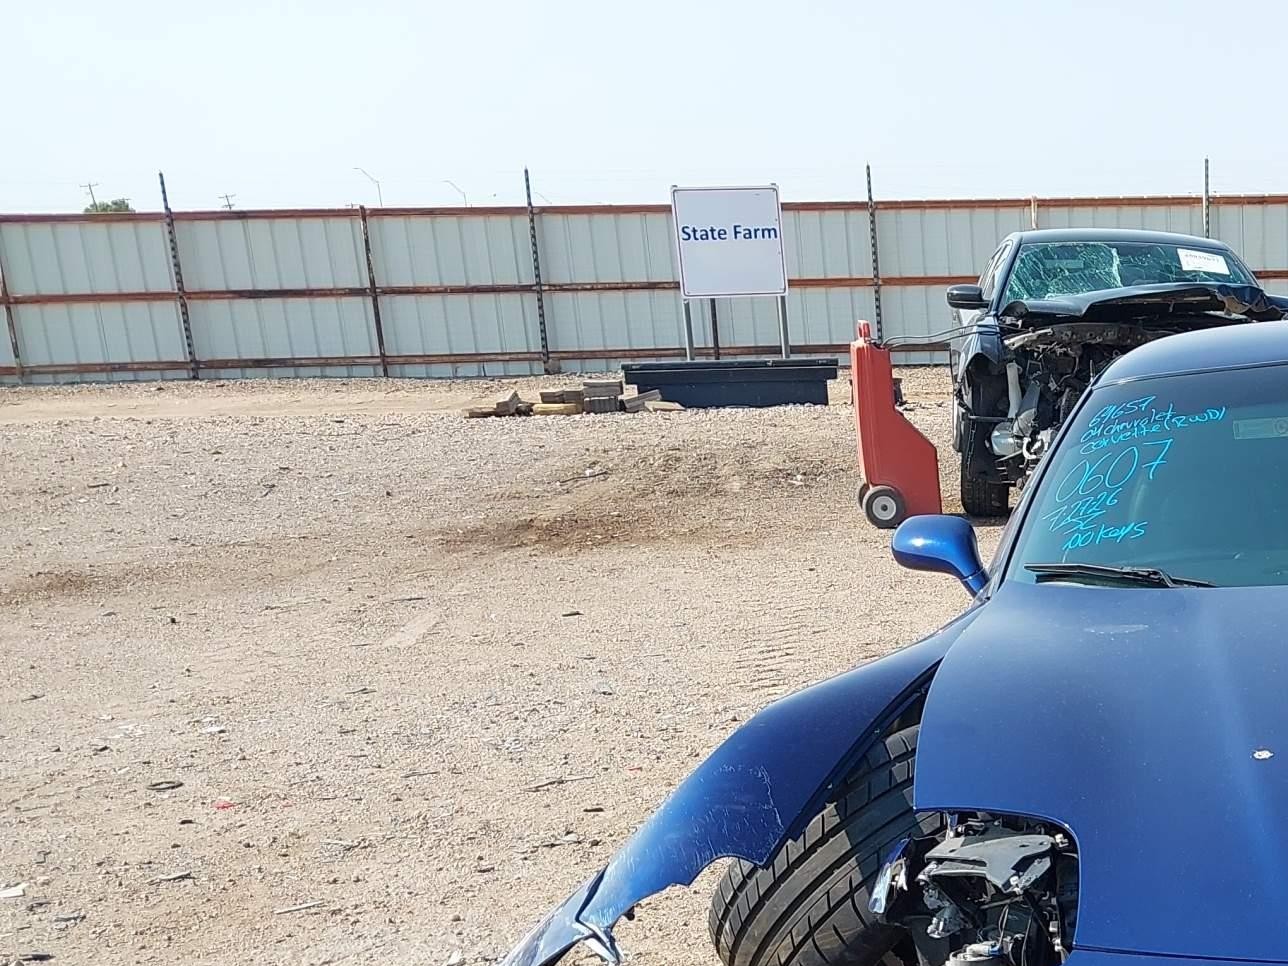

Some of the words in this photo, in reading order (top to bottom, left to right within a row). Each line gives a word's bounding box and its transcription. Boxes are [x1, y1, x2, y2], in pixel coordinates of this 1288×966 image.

[681, 225, 728, 241] State
[733, 225, 778, 240] Farm
[1055, 438, 1174, 503] 0607
